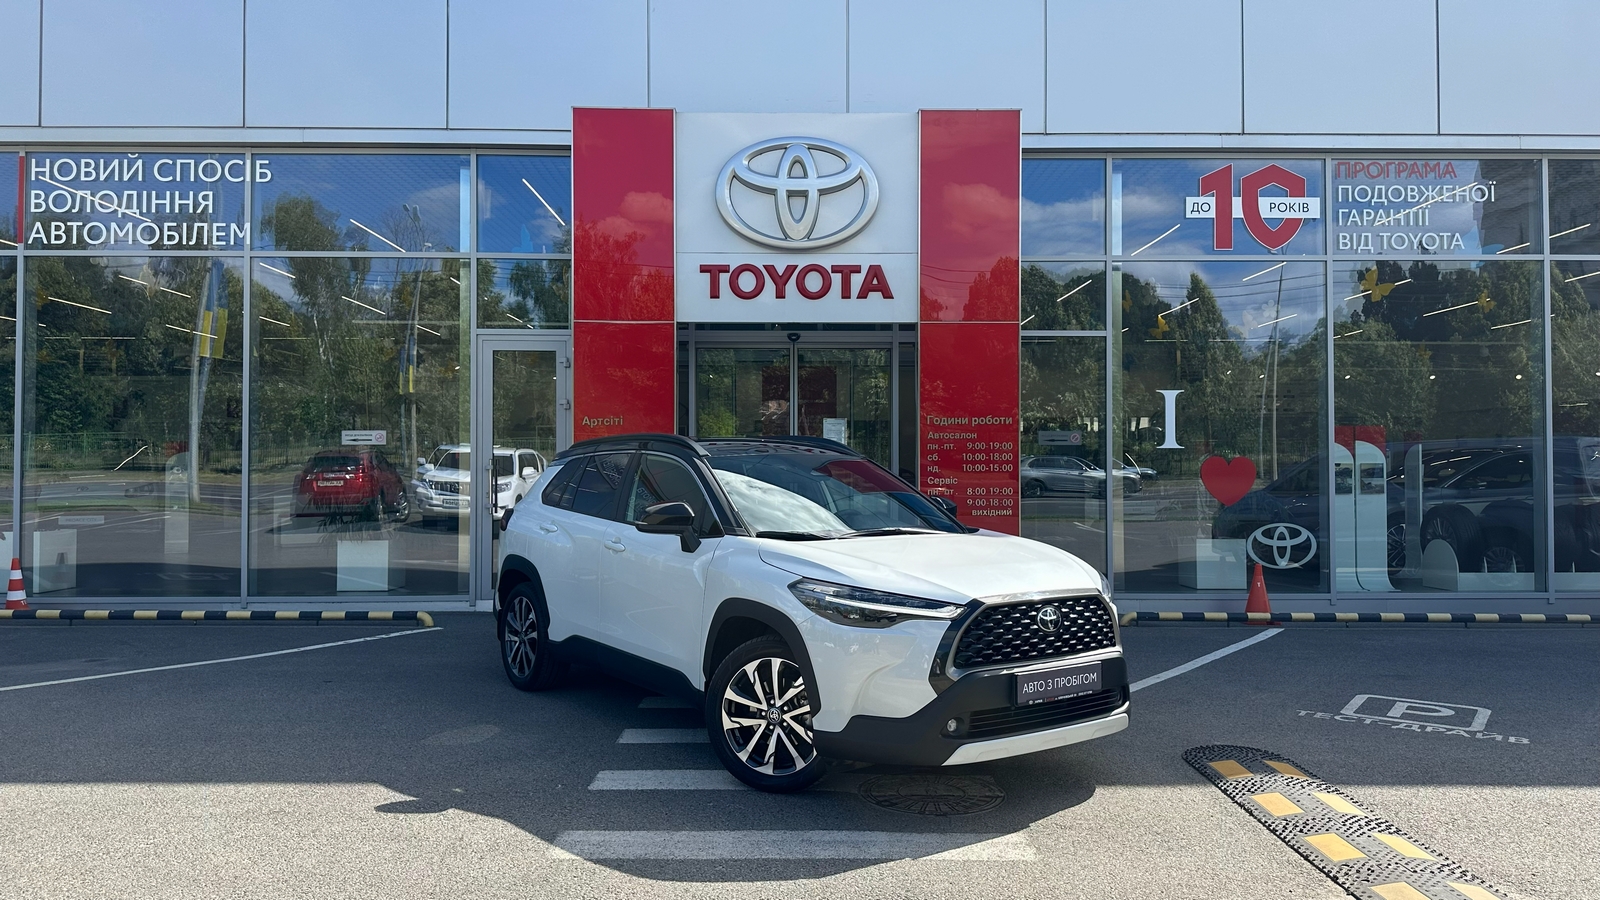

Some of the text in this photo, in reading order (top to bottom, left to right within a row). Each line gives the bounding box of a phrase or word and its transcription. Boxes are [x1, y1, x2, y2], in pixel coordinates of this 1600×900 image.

[30, 153, 272, 182] НОВИЙ СПОСІБ
[1337, 161, 1457, 179] ПРОГРАМА
[1338, 180, 1496, 205] ПОДОВЖЕНОЇ
[30, 190, 213, 217] ВОЛОДІННЯ
[1190, 163, 1310, 250] ДО 10 РОКІВ
[1338, 204, 1431, 226] ГАРАНТІЇ
[28, 222, 251, 246] АВТОМОБІЛЕМ
[1339, 233, 1465, 253] ВІД TOYOTA
[699, 263, 895, 301] TOYOTA
[582, 416, 623, 428] Артсіті
[927, 415, 1013, 427] Години роботи
[1156, 389, 1185, 449] I
[927, 431, 978, 440] Автосалон
[966, 442, 1013, 450] 9:00-19:00
[927, 452, 1013, 461] сб. 10:00-18:00
[927, 464, 1013, 473] нд. 10:00-15:00
[927, 476, 958, 486] Сервіс
[966, 499, 1013, 507] 9:00-18:00
[971, 508, 1012, 517] вихідний
[1022, 680, 1045, 694] АВТО
[1054, 672, 1097, 689] ПРОБІГОМ
[1296, 709, 1531, 745] ТЕСТ-ДРАЙВ
